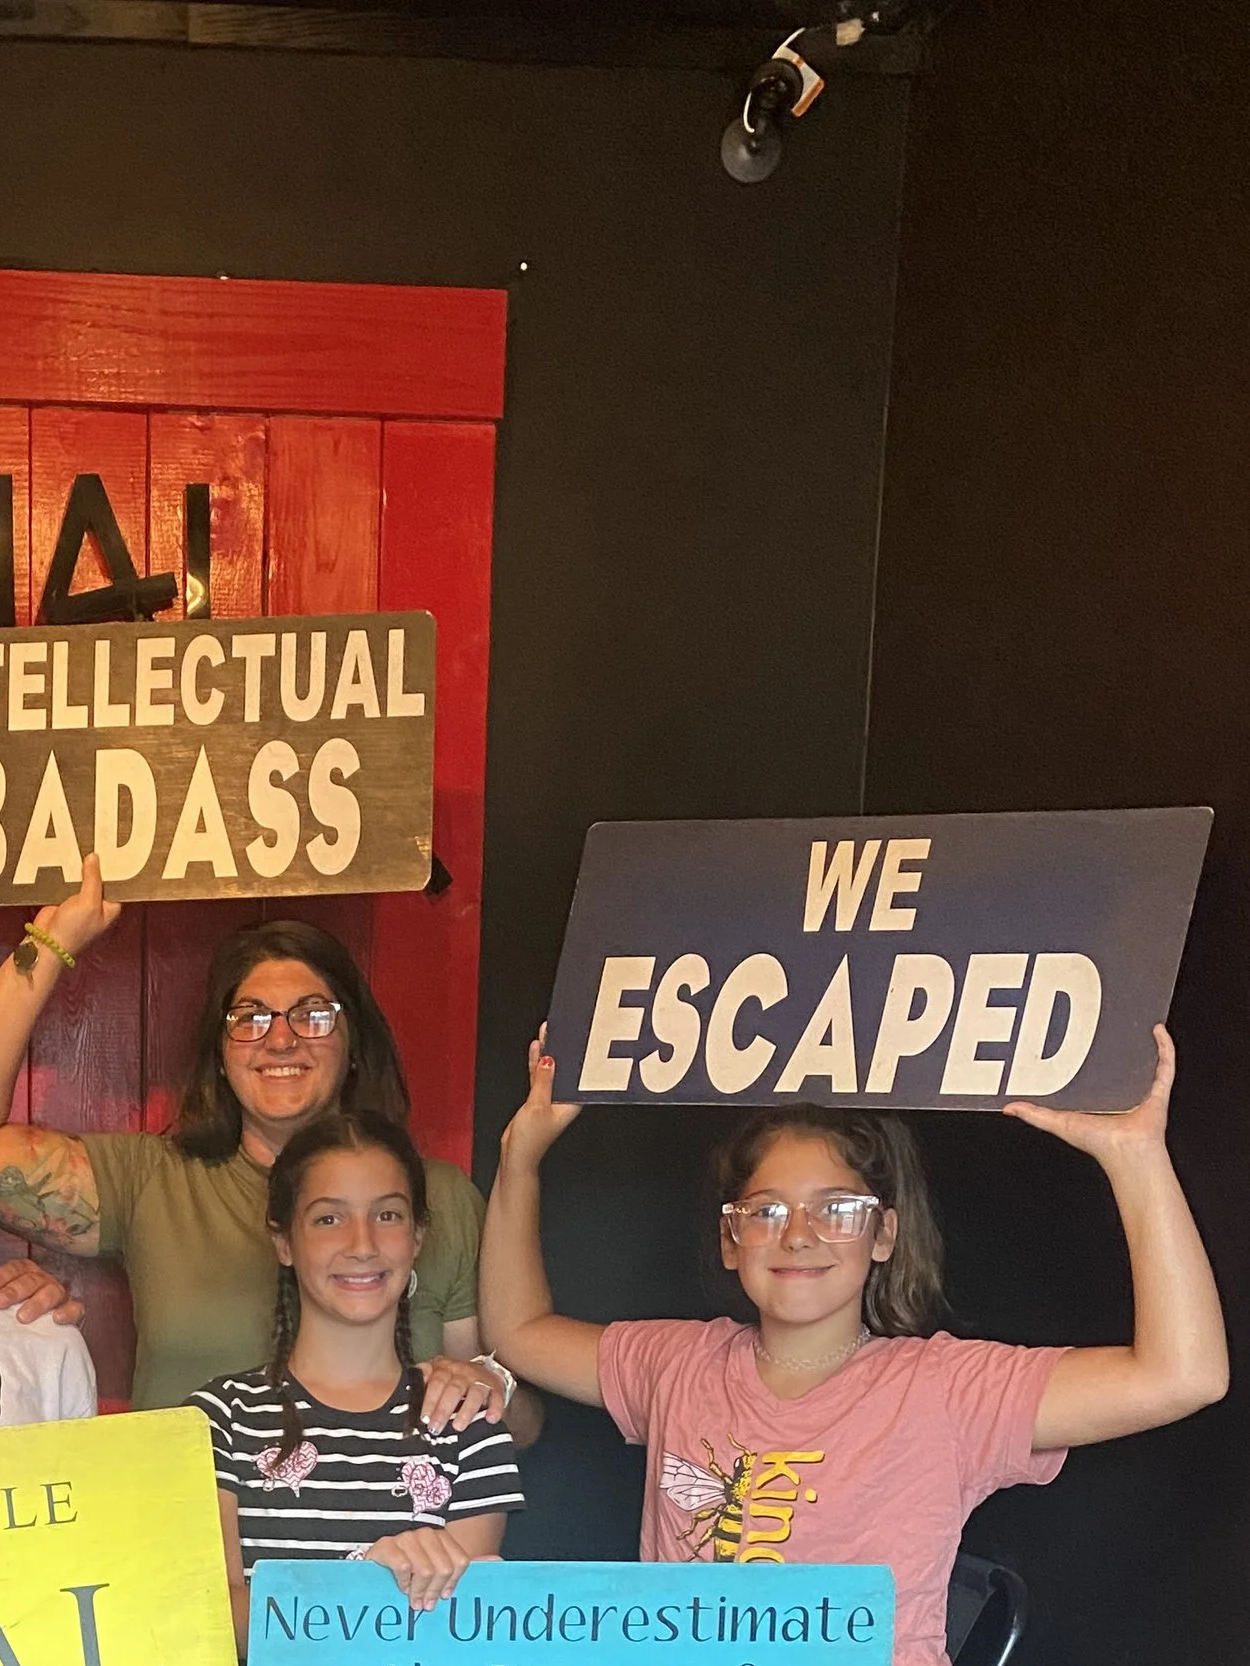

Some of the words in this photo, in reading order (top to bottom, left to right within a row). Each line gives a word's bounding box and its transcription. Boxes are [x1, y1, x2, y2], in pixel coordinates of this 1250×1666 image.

[803, 838, 932, 932] WE
[578, 952, 1102, 1096] ESCAPED
[739, 1450, 826, 1563] kin
[264, 1596, 425, 1642] Never
[449, 1593, 876, 1642] Underestimate
